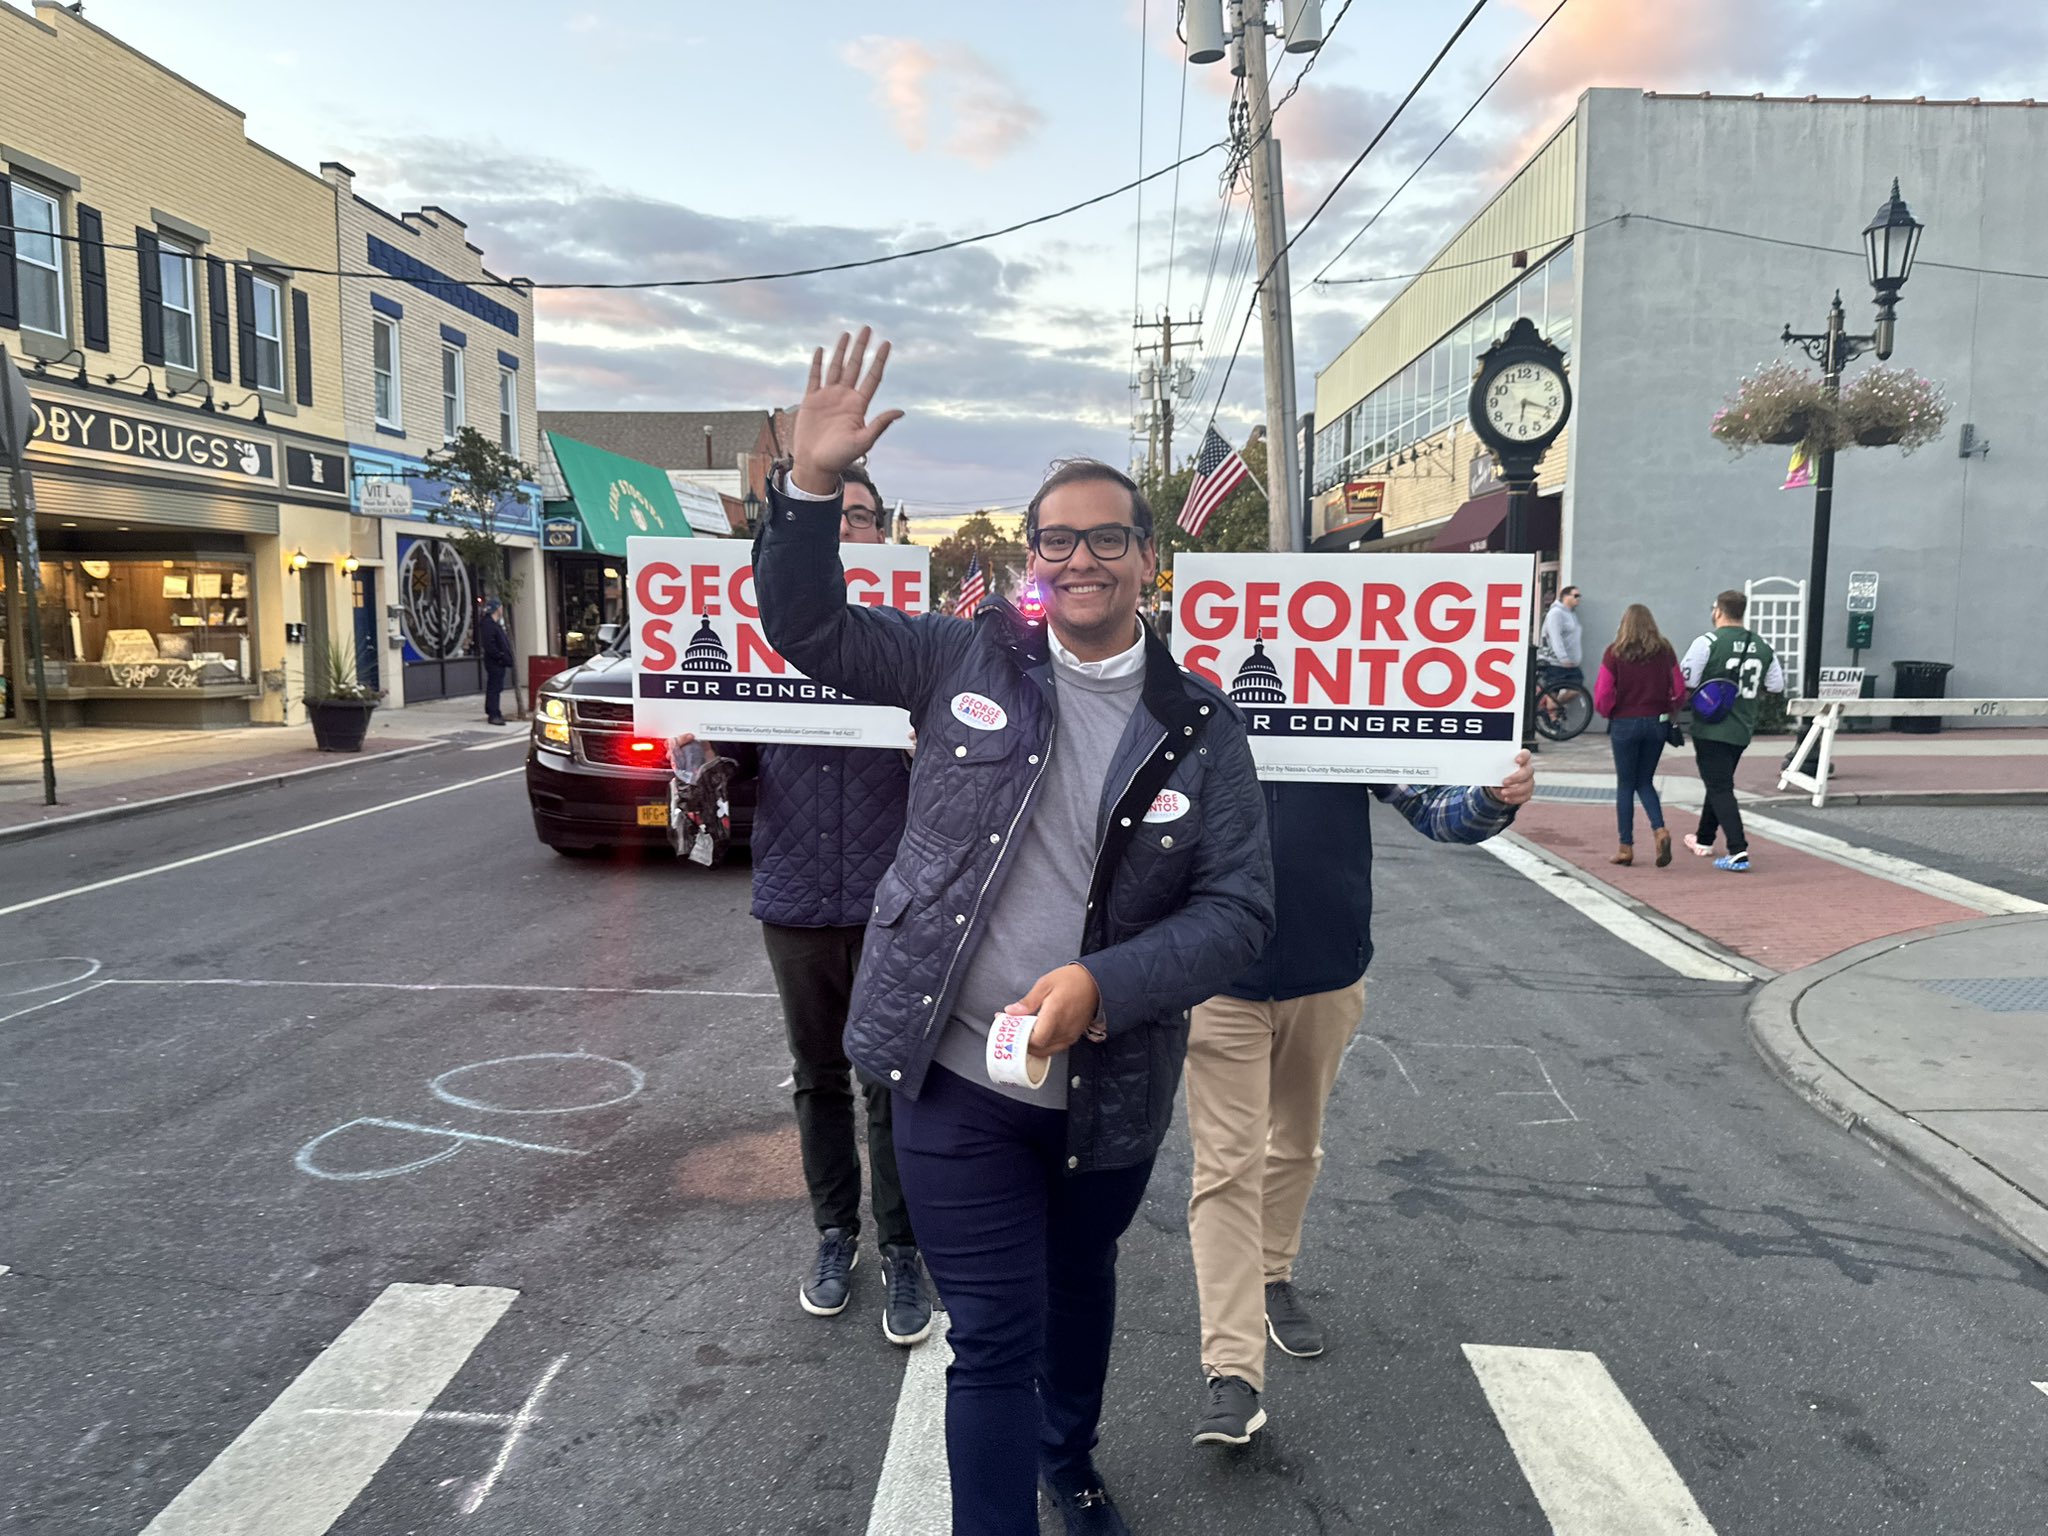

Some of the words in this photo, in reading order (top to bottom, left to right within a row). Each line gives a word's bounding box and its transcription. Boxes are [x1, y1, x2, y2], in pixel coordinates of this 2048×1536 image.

[1504, 373, 1516, 384] 11
[1517, 368, 1532, 379] 12
[1495, 384, 1508, 396] 10
[1544, 381, 1553, 392] 2
[1490, 397, 1498, 408] 9
[1549, 396, 1557, 407] 3
[1494, 411, 1503, 422] 8
[1542, 408, 1551, 420] 4
[1504, 422, 1513, 433] 7
[1519, 425, 1527, 436] 6
[1533, 421, 1541, 432] 5
[109, 418, 229, 468] DRUGS
[1180, 579, 1523, 643] GEORGE
[1820, 670, 1863, 682] ELDIN
[665, 680, 720, 696] FOR
[736, 682, 856, 700] CONGR
[1820, 688, 1858, 697] VERNOR
[962, 694, 1002, 718] GEORGE
[1289, 715, 1484, 734] CONGRESS
[1307, 766, 1329, 774] County
[1330, 766, 1364, 775] Republican
[1156, 794, 1179, 803] RGE
[1150, 803, 1179, 812] NTOS
